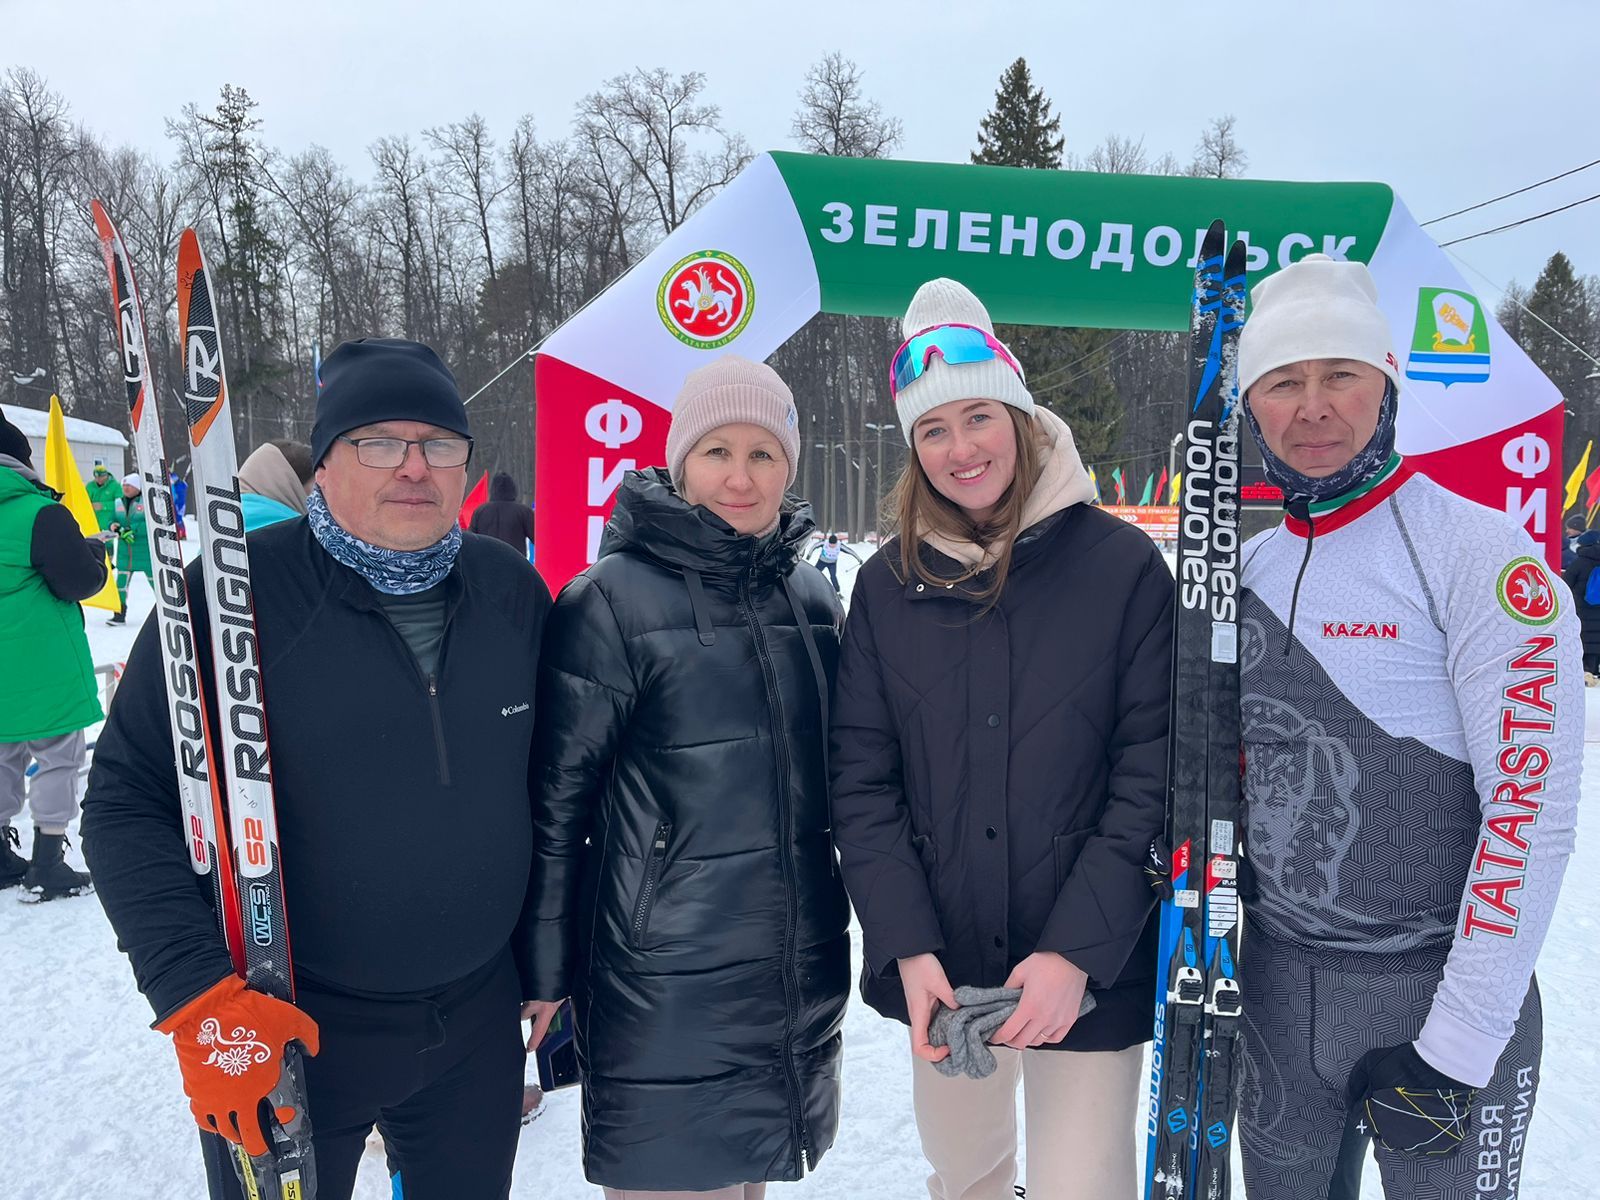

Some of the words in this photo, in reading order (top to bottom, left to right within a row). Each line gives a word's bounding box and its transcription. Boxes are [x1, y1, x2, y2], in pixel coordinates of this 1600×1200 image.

[585, 398, 643, 565] ФИ
[1501, 432, 1551, 560] ФИ
[145, 458, 209, 782] ROSSIGNOL
[205, 475, 273, 784] ROSSIGNOL
[1321, 621, 1399, 640] KAZAN
[243, 817, 267, 866] S2
[1461, 633, 1558, 940] TATARSTAN
[252, 888, 270, 940] WCS
